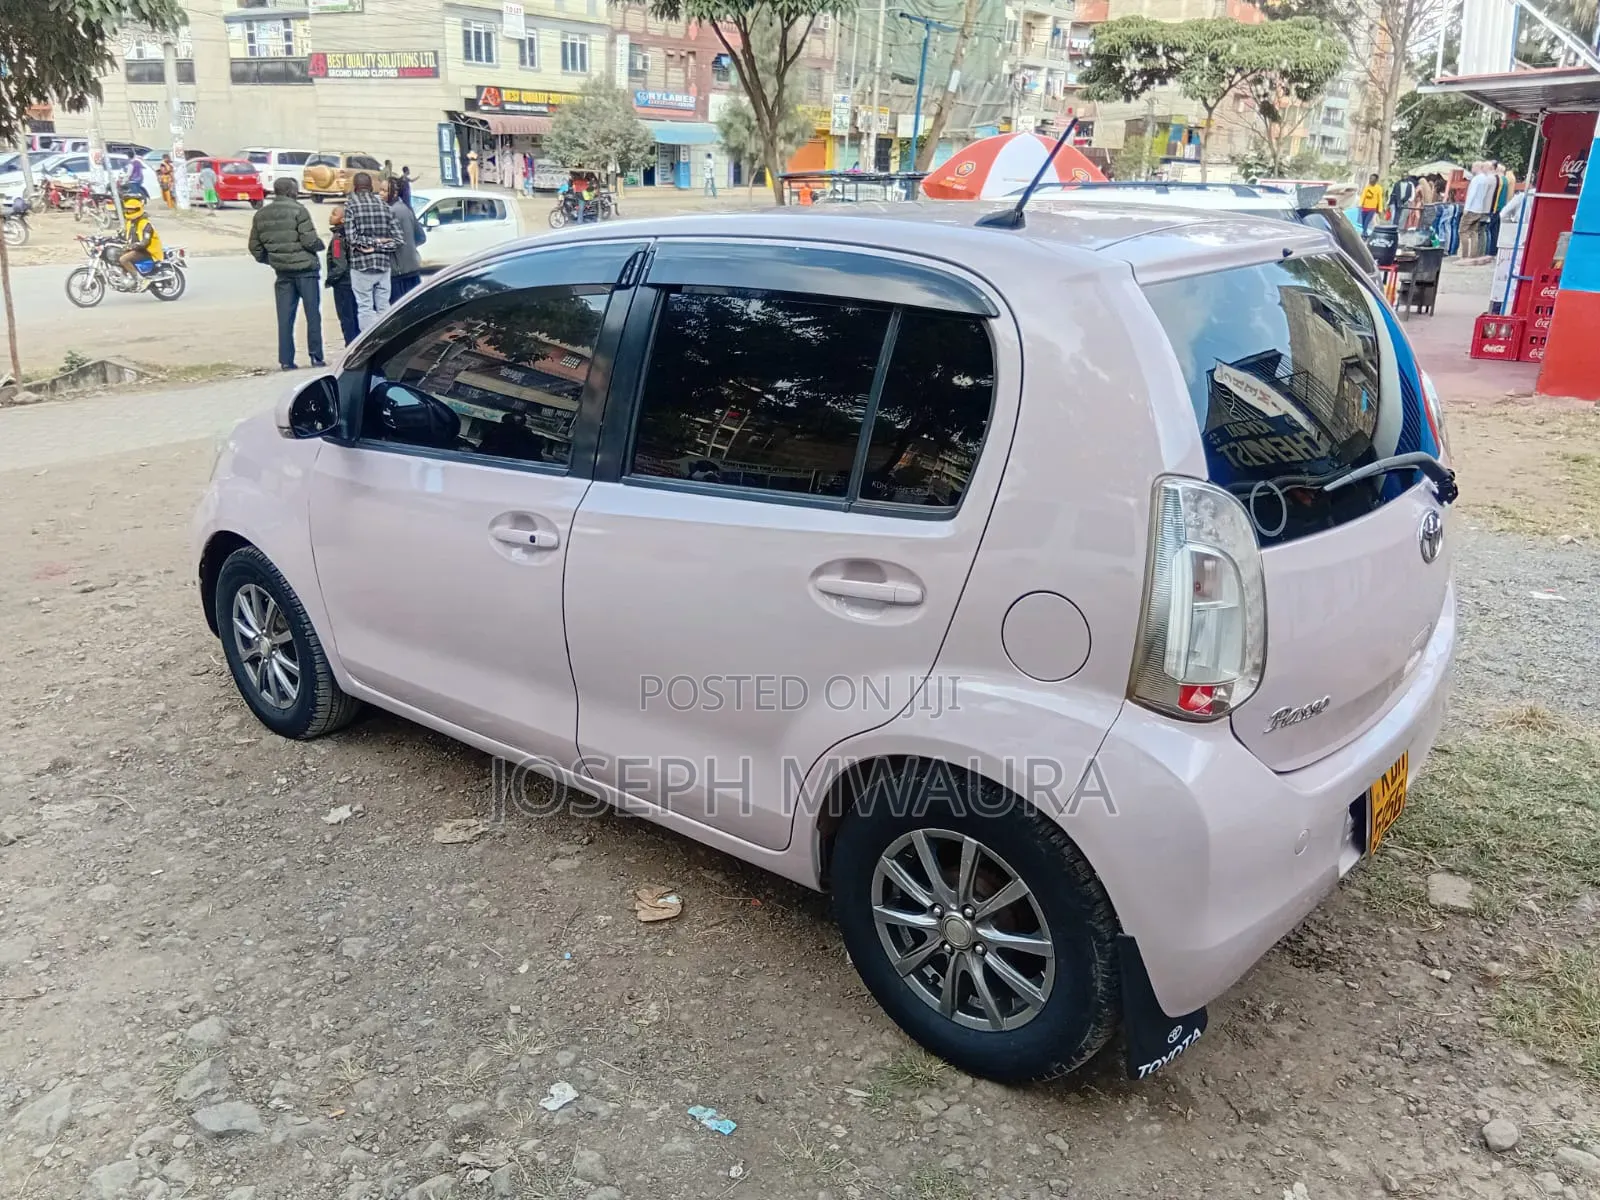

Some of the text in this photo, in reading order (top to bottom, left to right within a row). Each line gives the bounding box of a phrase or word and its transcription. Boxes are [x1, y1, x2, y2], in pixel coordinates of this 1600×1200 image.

[326, 53, 345, 68] BEST
[346, 52, 377, 68] QUALITY
[378, 51, 419, 68] SOLUTIONS
[328, 69, 352, 77] SECOND
[352, 69, 370, 77] HAND
[371, 69, 398, 77] CLOTHES
[1138, 1027, 1202, 1080] TOYOTA
